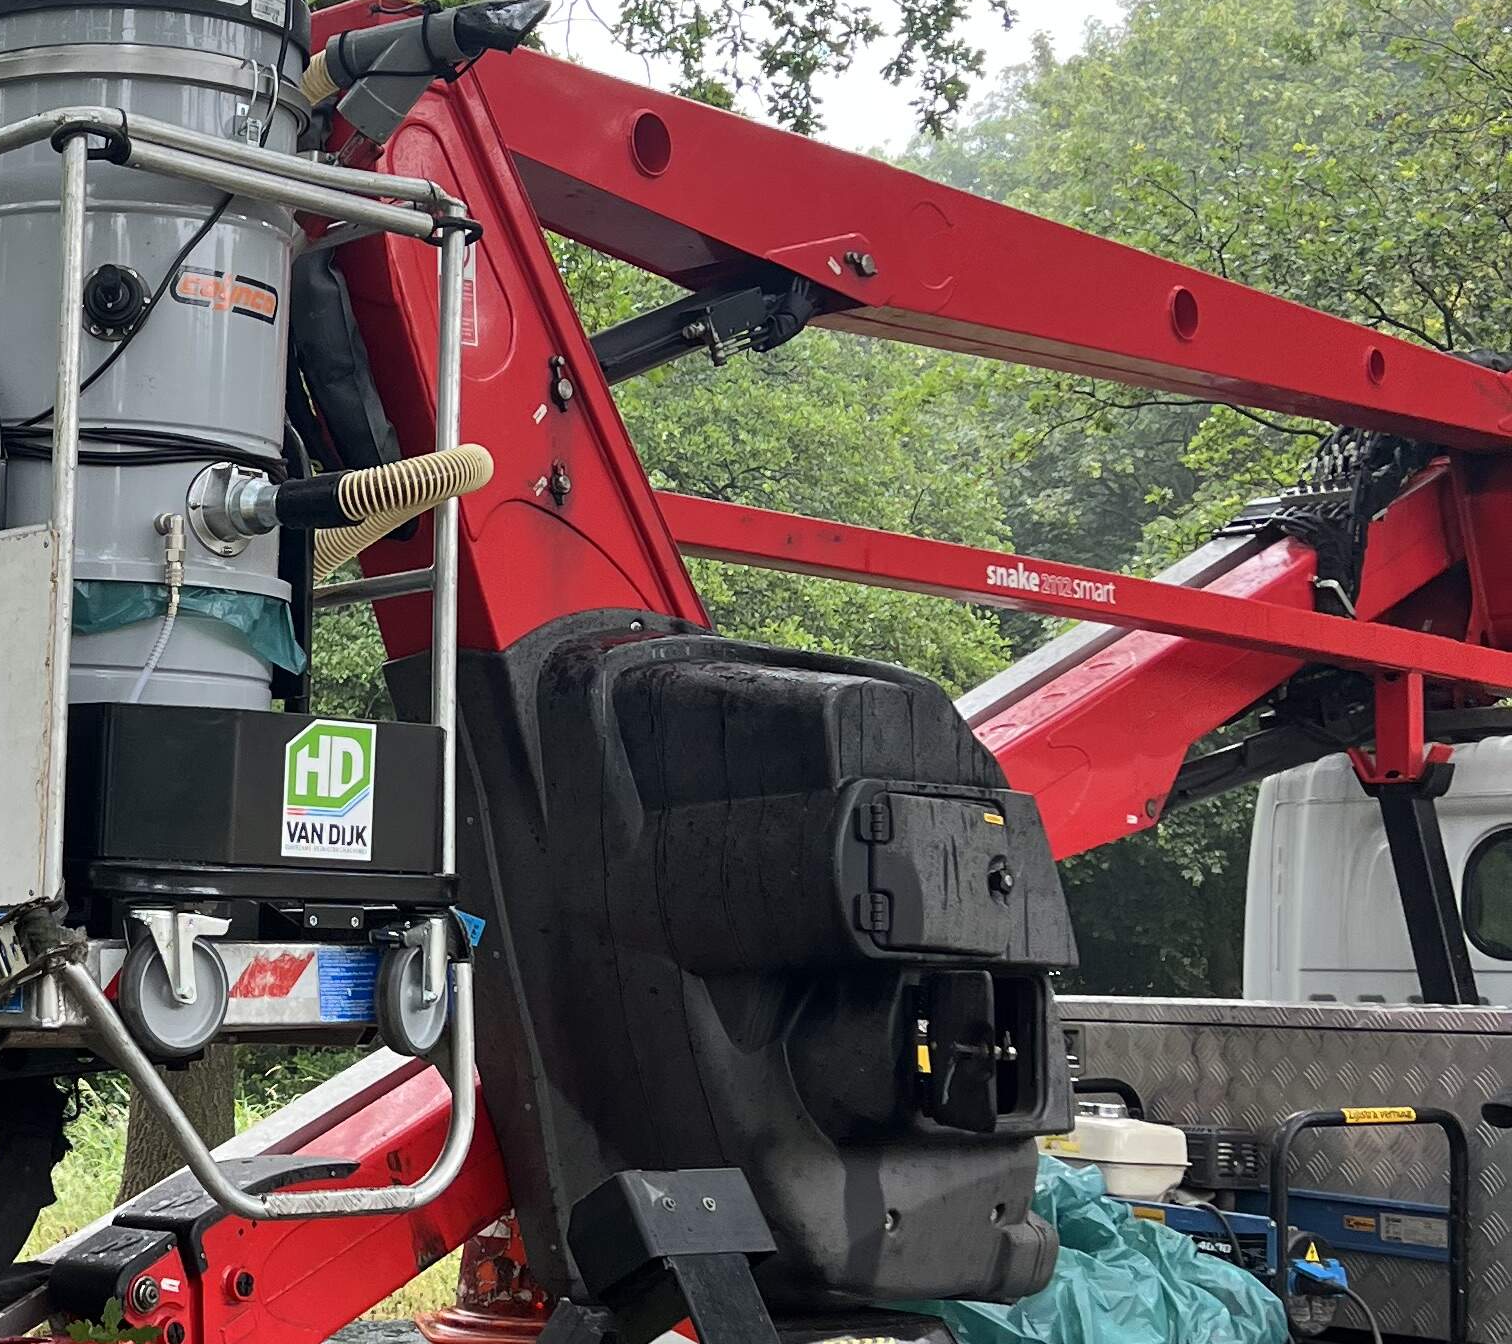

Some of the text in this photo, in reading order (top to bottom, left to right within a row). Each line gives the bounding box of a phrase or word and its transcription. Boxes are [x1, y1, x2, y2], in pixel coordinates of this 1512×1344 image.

[986, 562, 1040, 592] snake
[1073, 578, 1116, 605] smart
[295, 735, 364, 797] HD
[286, 821, 368, 848] VAN DIJK
